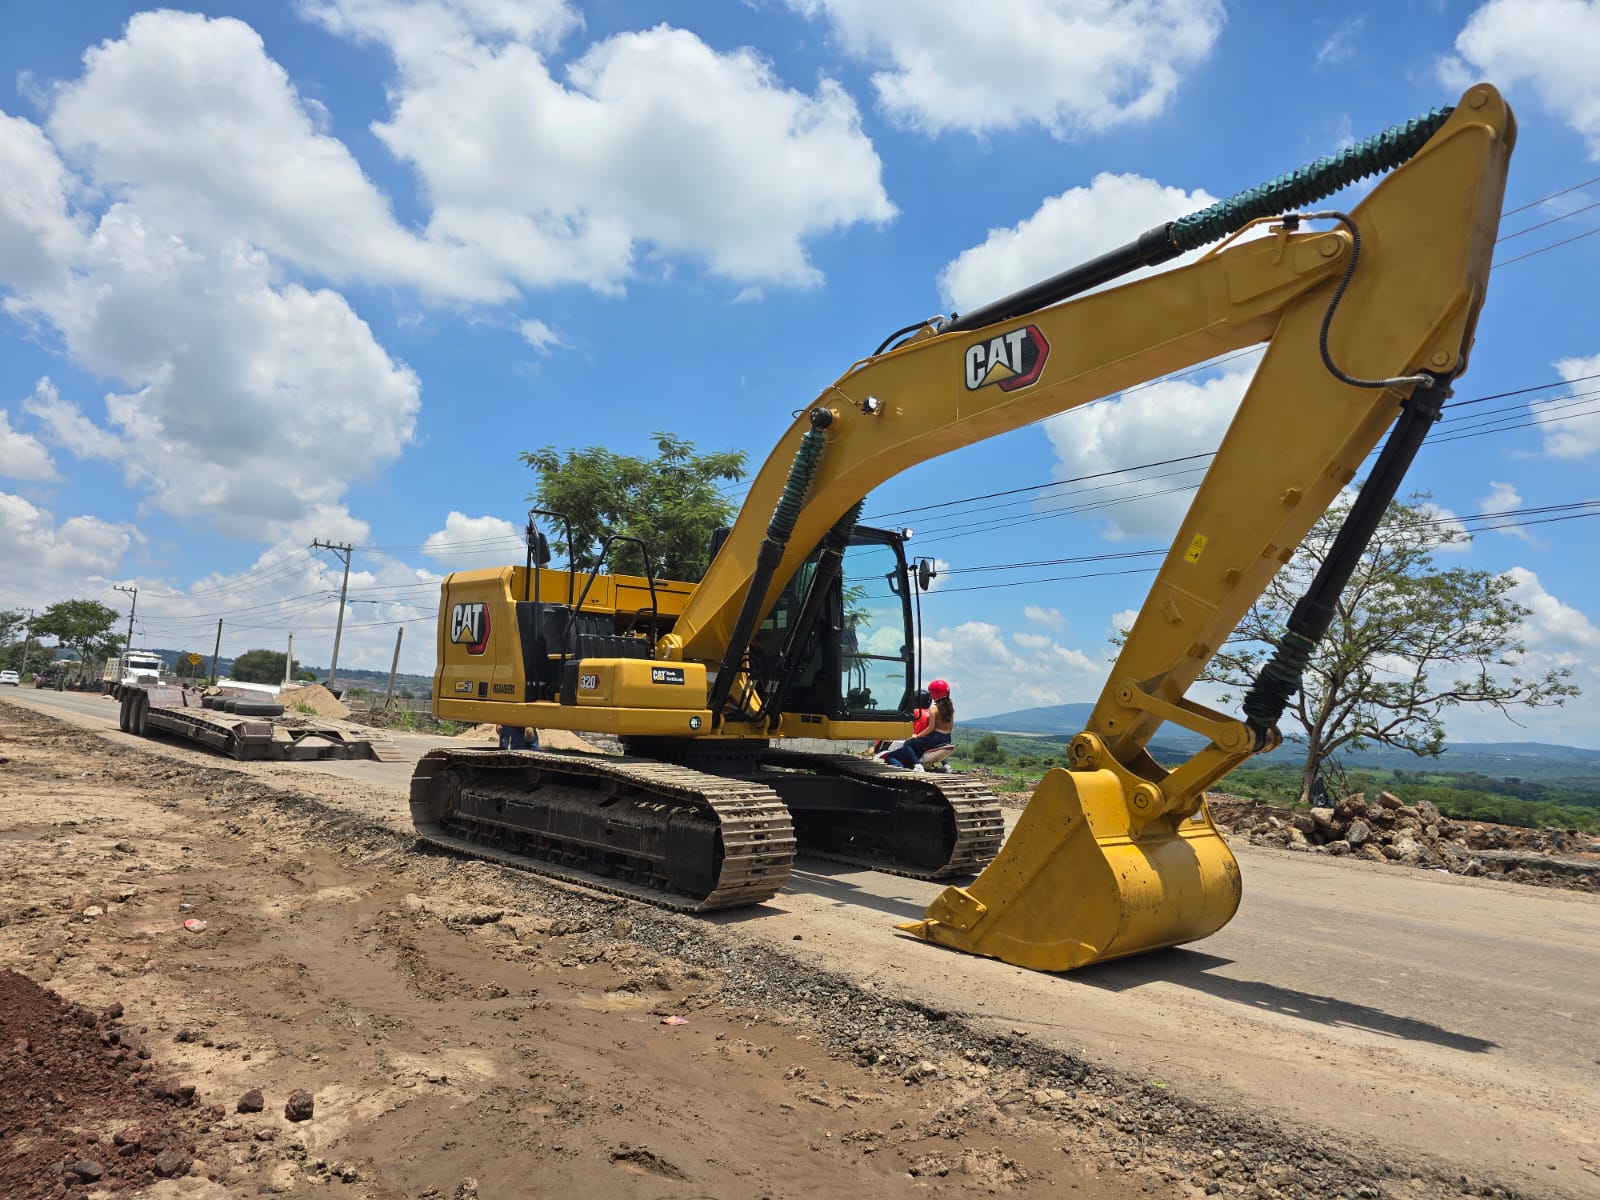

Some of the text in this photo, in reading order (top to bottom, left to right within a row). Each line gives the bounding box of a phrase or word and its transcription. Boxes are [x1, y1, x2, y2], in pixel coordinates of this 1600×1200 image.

[965, 328, 1027, 389] CAT
[451, 604, 483, 642] CAT
[580, 675, 596, 689] 320
[653, 670, 666, 681] CAT
